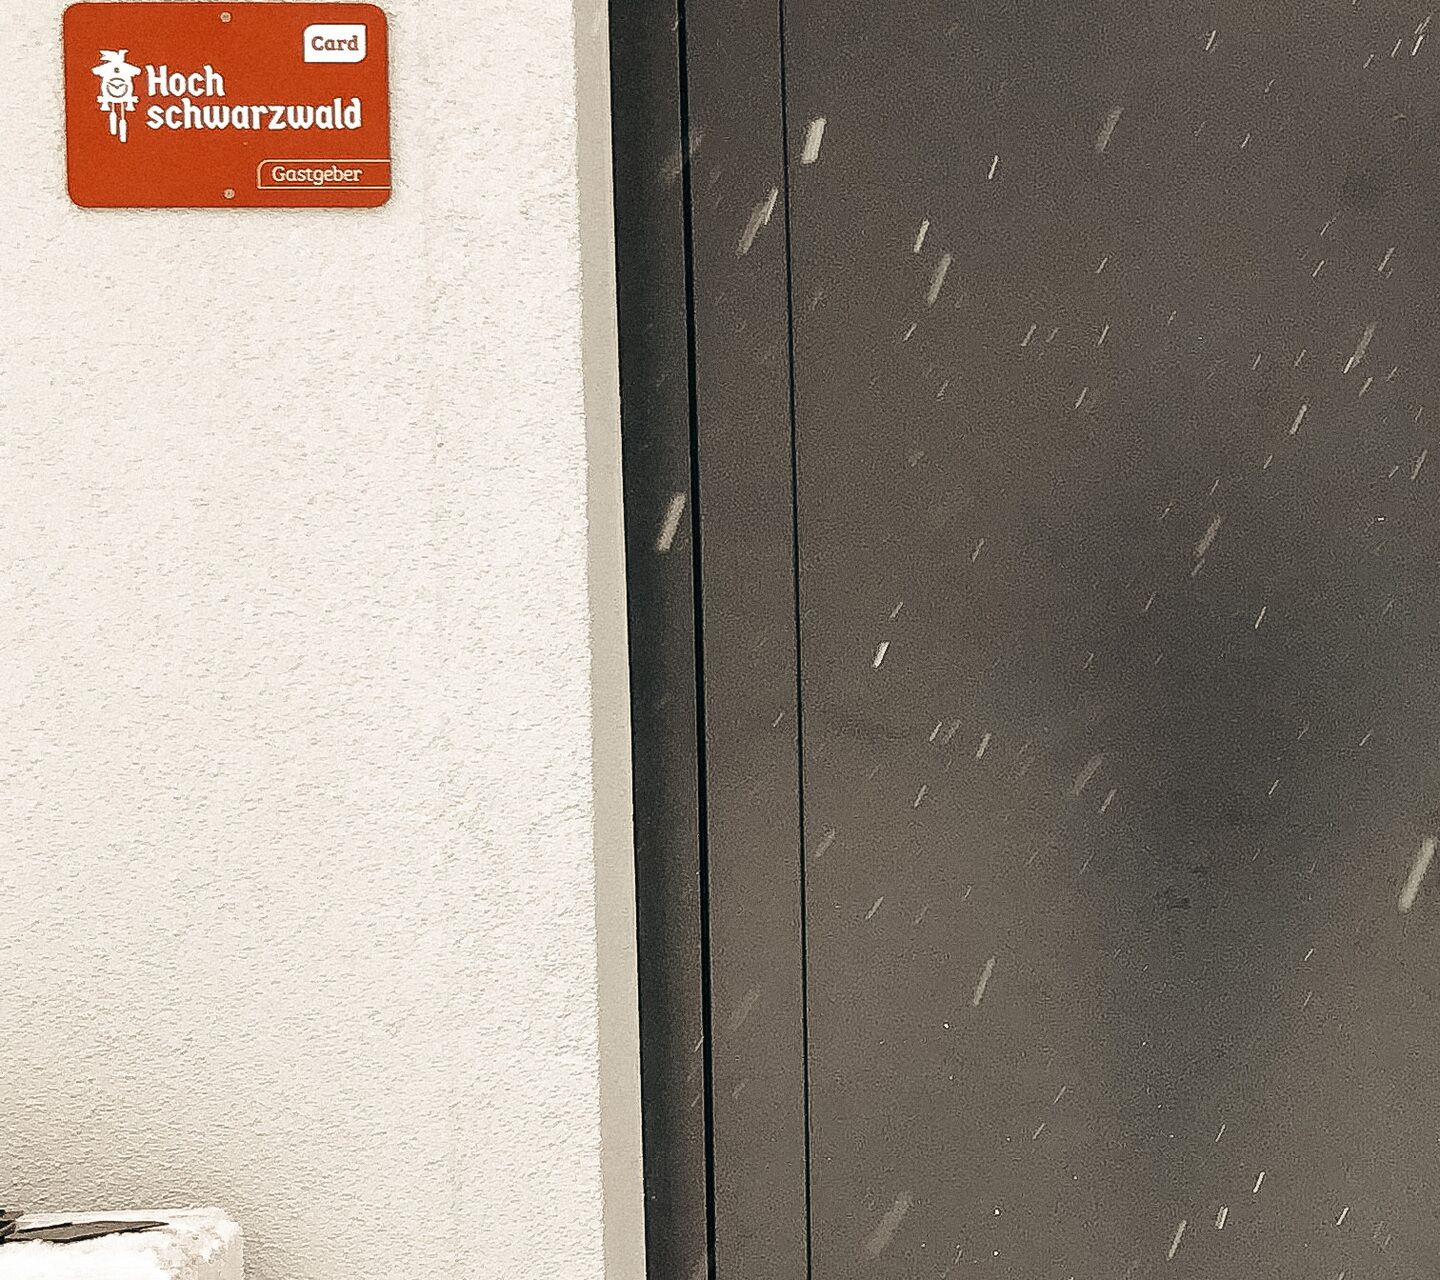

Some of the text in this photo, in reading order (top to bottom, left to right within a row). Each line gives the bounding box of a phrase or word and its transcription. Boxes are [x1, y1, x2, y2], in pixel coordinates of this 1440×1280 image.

[311, 35, 359, 52] Card
[145, 64, 226, 97] Hoch
[145, 97, 362, 130] schwarzwald
[271, 166, 363, 185] Gastgeber
